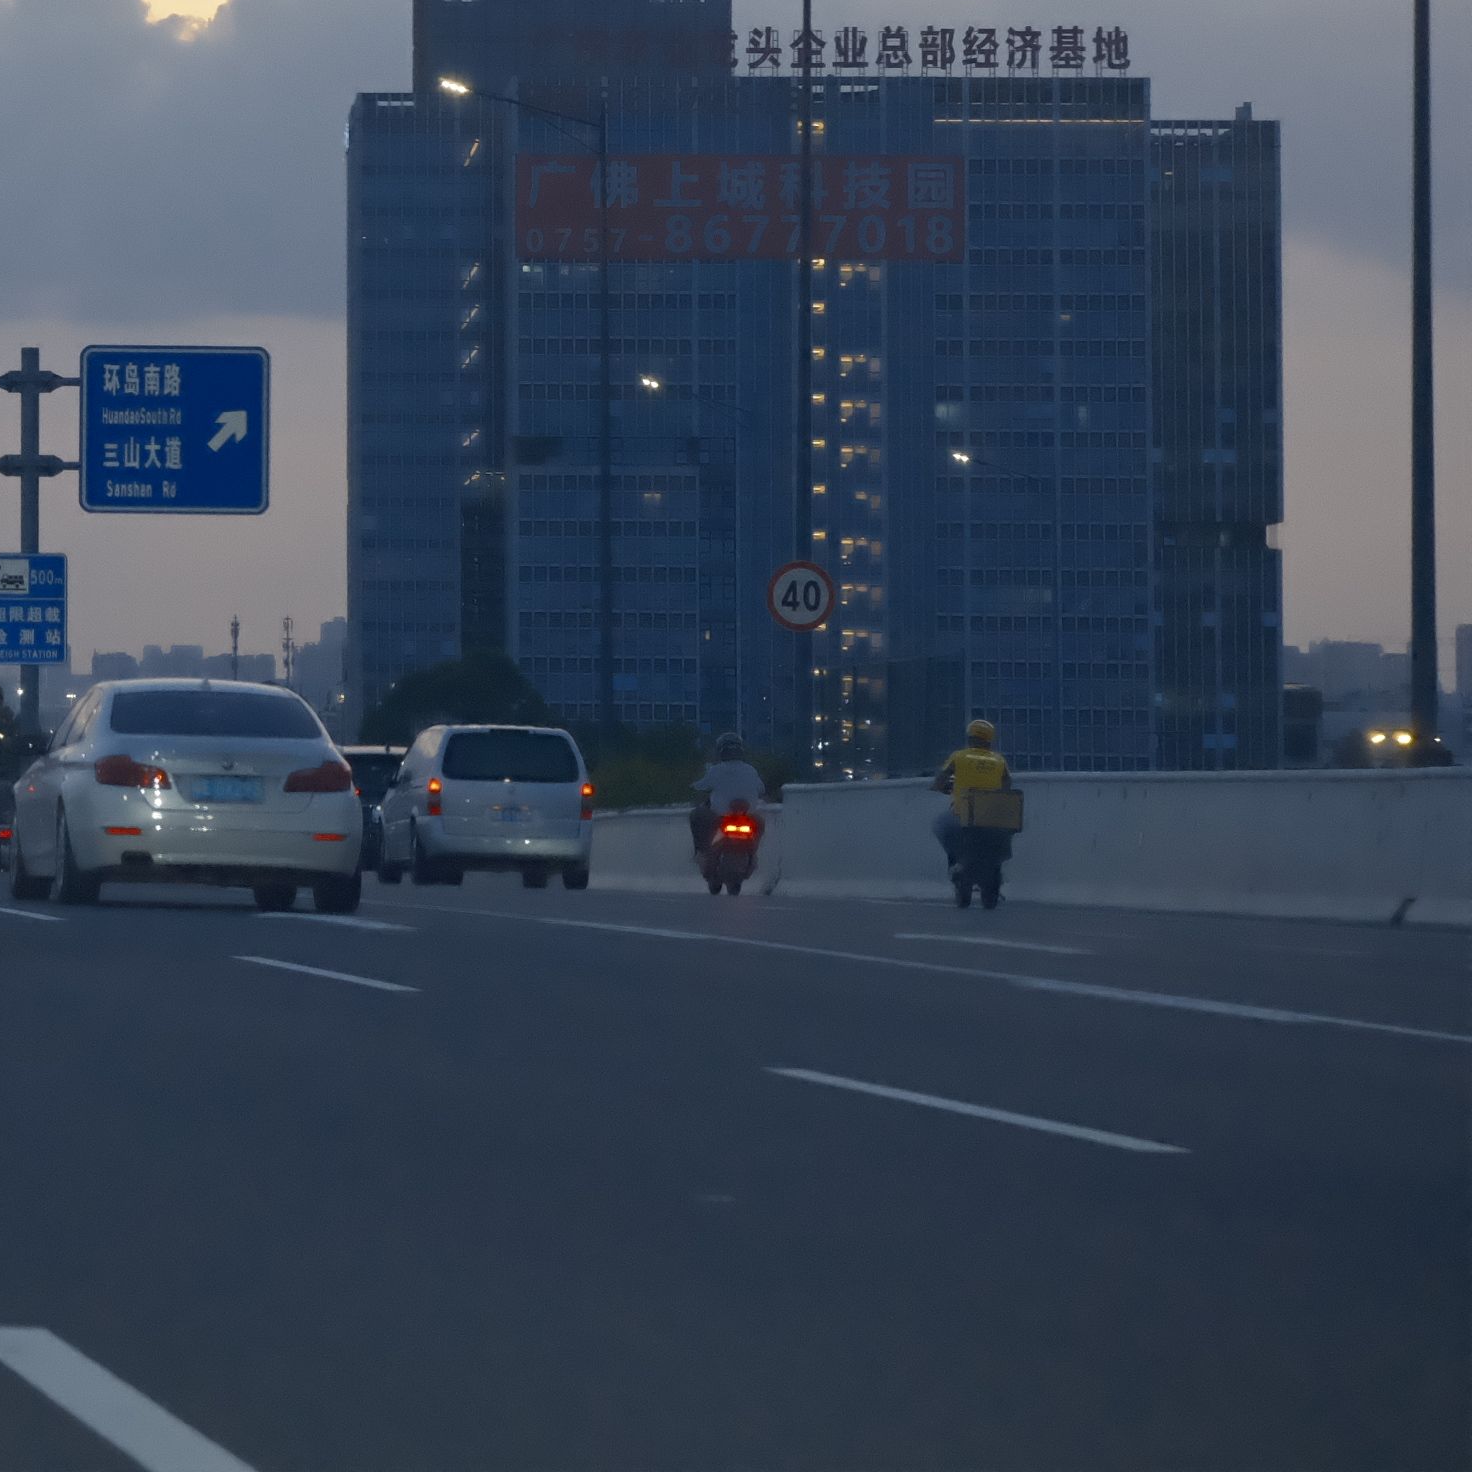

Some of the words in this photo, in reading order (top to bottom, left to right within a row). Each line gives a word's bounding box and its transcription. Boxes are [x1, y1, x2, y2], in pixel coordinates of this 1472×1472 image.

[529, 160, 955, 210] 广佛上城科技园
[103, 362, 181, 397] 环岛南路
[103, 436, 183, 469] 三山大道
[106, 480, 152, 498] Sanshan
[162, 480, 177, 498] Rd
[781, 580, 821, 612] 40
[22, 649, 58, 659] STATION
